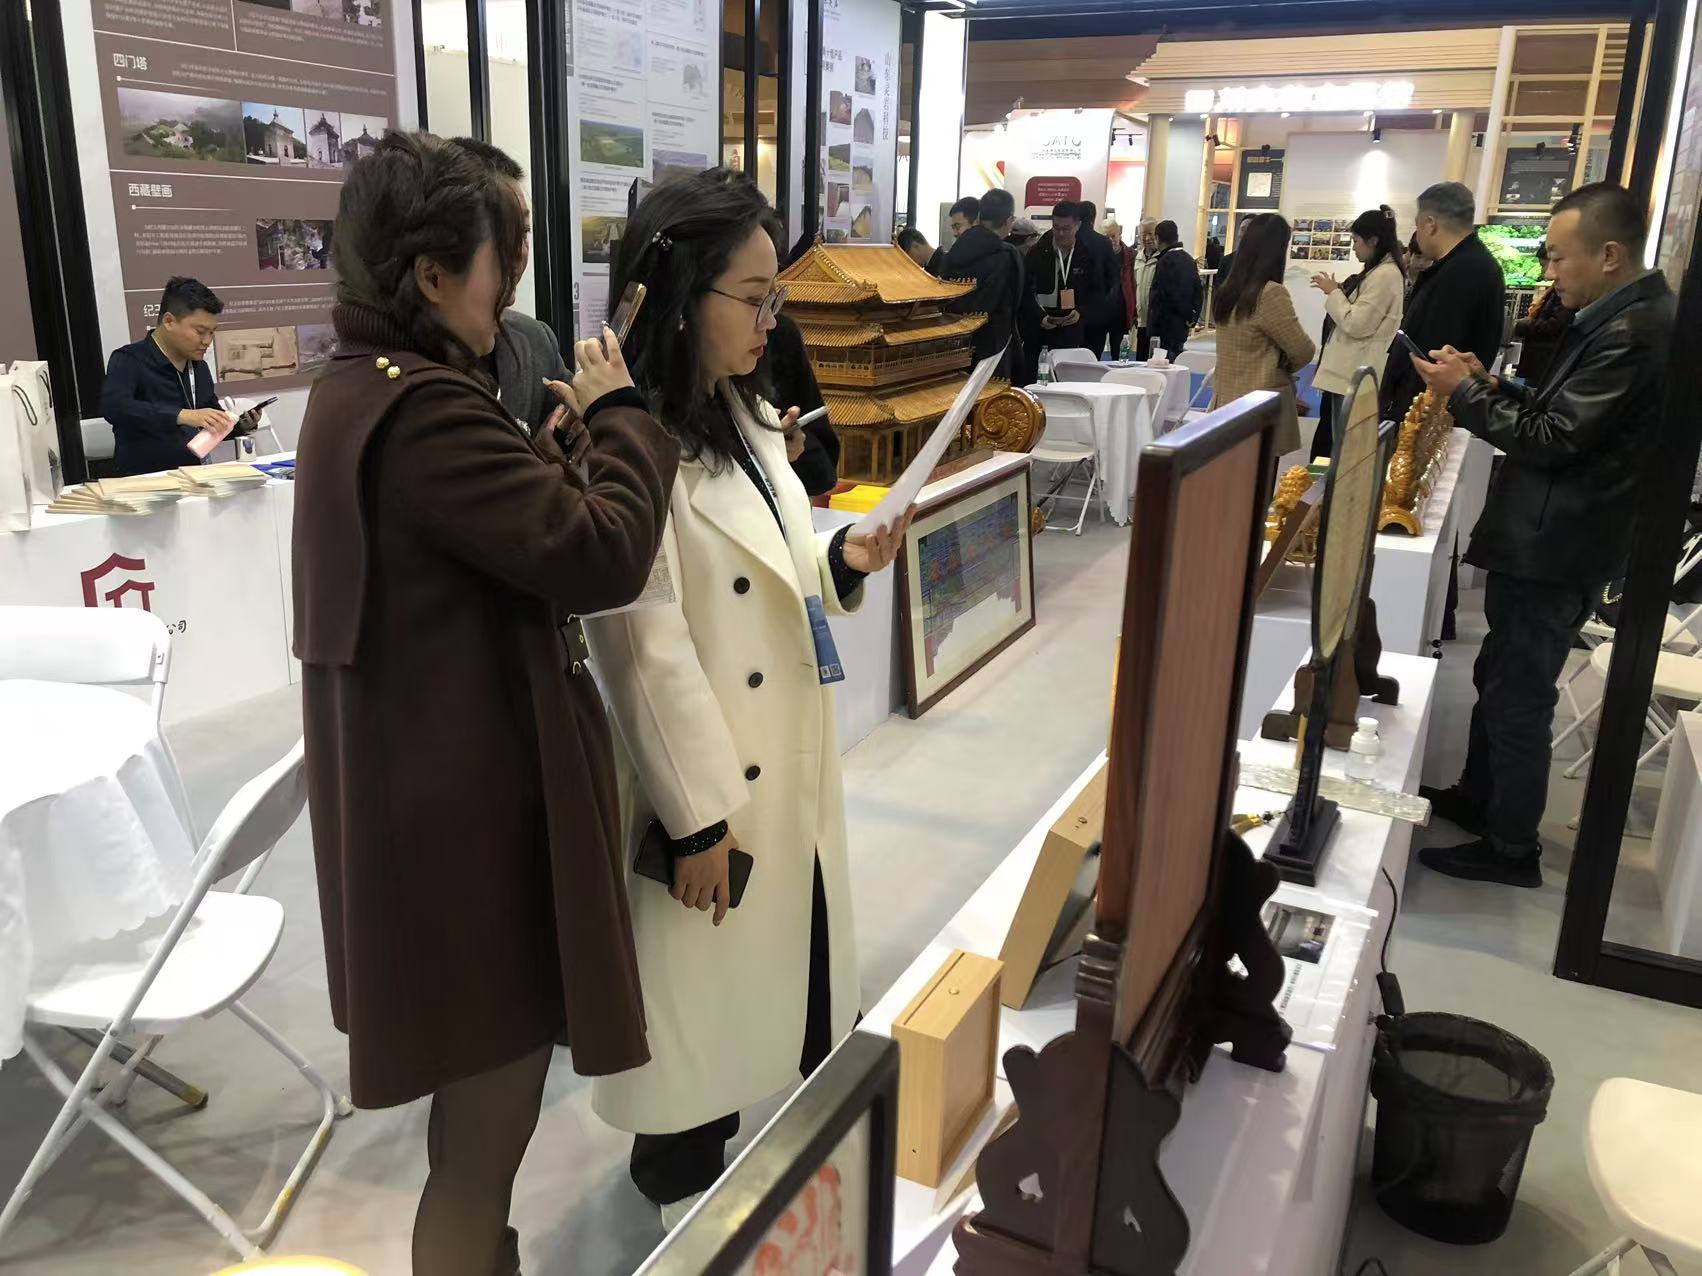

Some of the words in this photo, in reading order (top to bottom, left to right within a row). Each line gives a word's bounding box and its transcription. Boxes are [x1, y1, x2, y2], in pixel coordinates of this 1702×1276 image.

[113, 53, 147, 71] 四门塔
[128, 183, 173, 198] 西藏壁画
